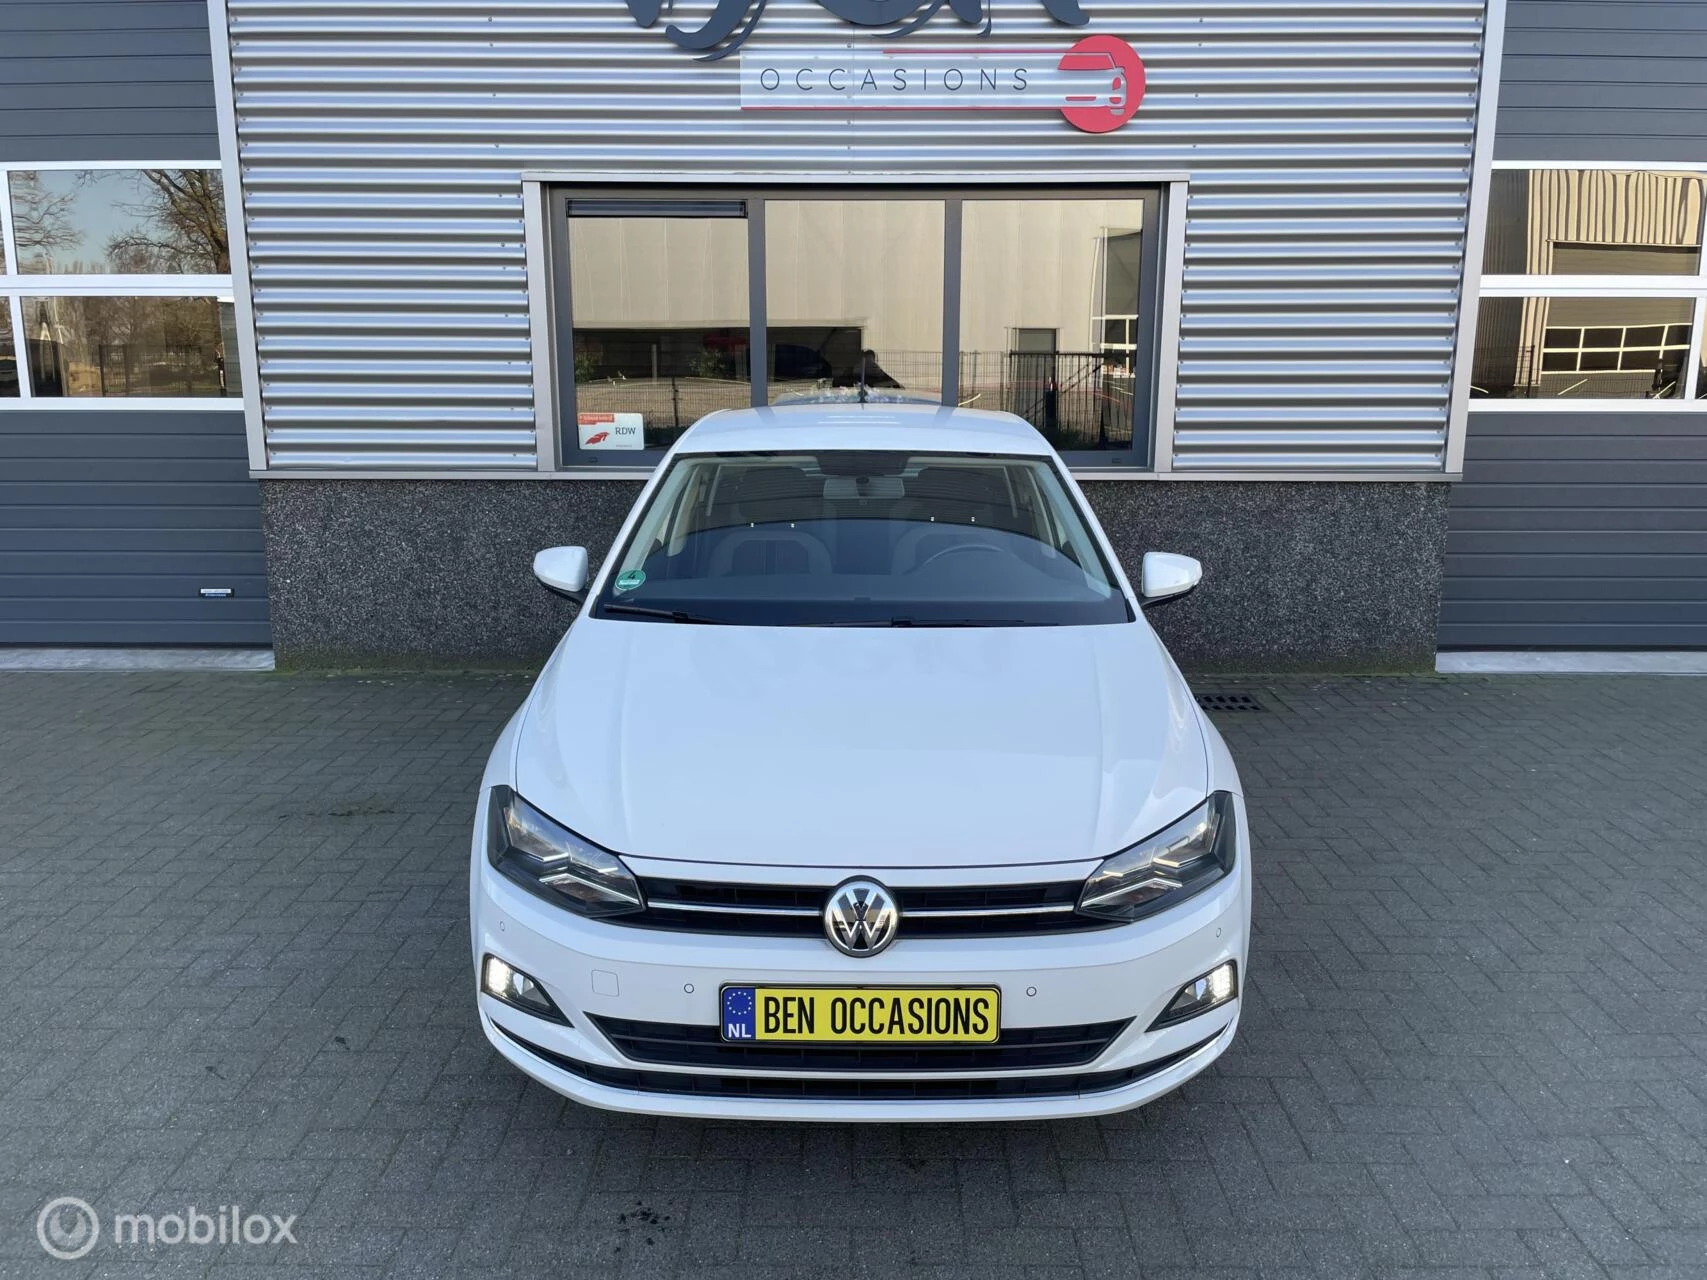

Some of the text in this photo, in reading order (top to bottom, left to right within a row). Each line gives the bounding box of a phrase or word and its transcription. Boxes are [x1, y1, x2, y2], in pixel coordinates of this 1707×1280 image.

[760, 68, 1029, 91] OCCASIONS
[615, 427, 636, 435] RDW
[764, 996, 990, 1035] BEN OCCASIONS
[728, 1023, 752, 1038] NL
